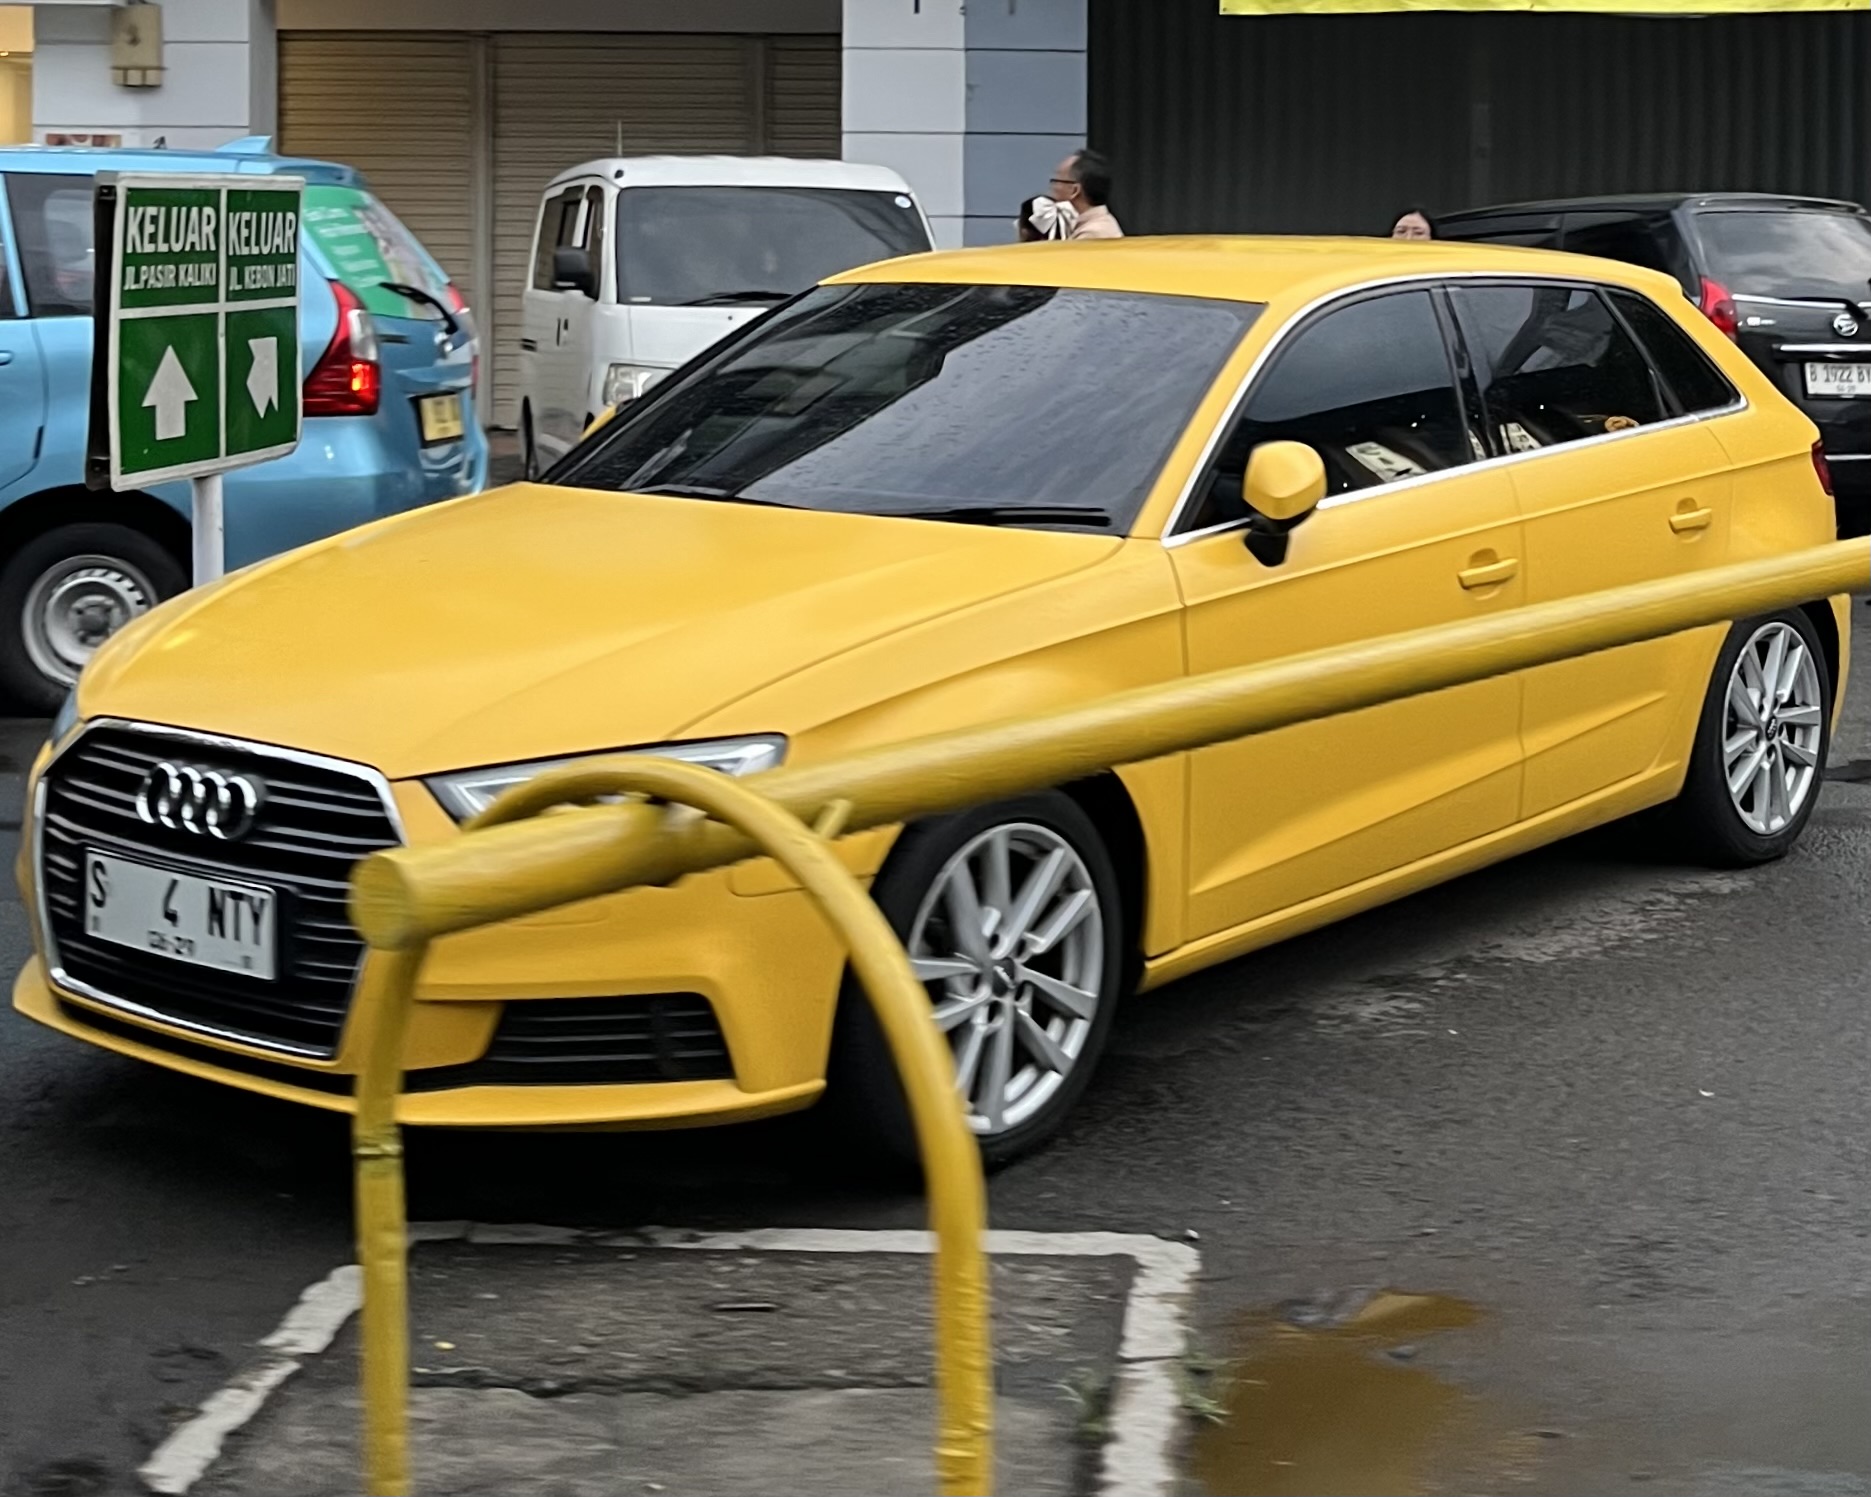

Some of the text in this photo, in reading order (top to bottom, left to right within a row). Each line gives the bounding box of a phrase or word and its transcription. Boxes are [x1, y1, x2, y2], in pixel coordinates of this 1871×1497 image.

[126, 206, 217, 253] KELUAR
[228, 211, 297, 256] KELUAR
[178, 262, 217, 287] KALIKI
[244, 265, 275, 289] KEBON
[276, 263, 296, 287] JATI
[91, 860, 266, 946] S 4 NTY
